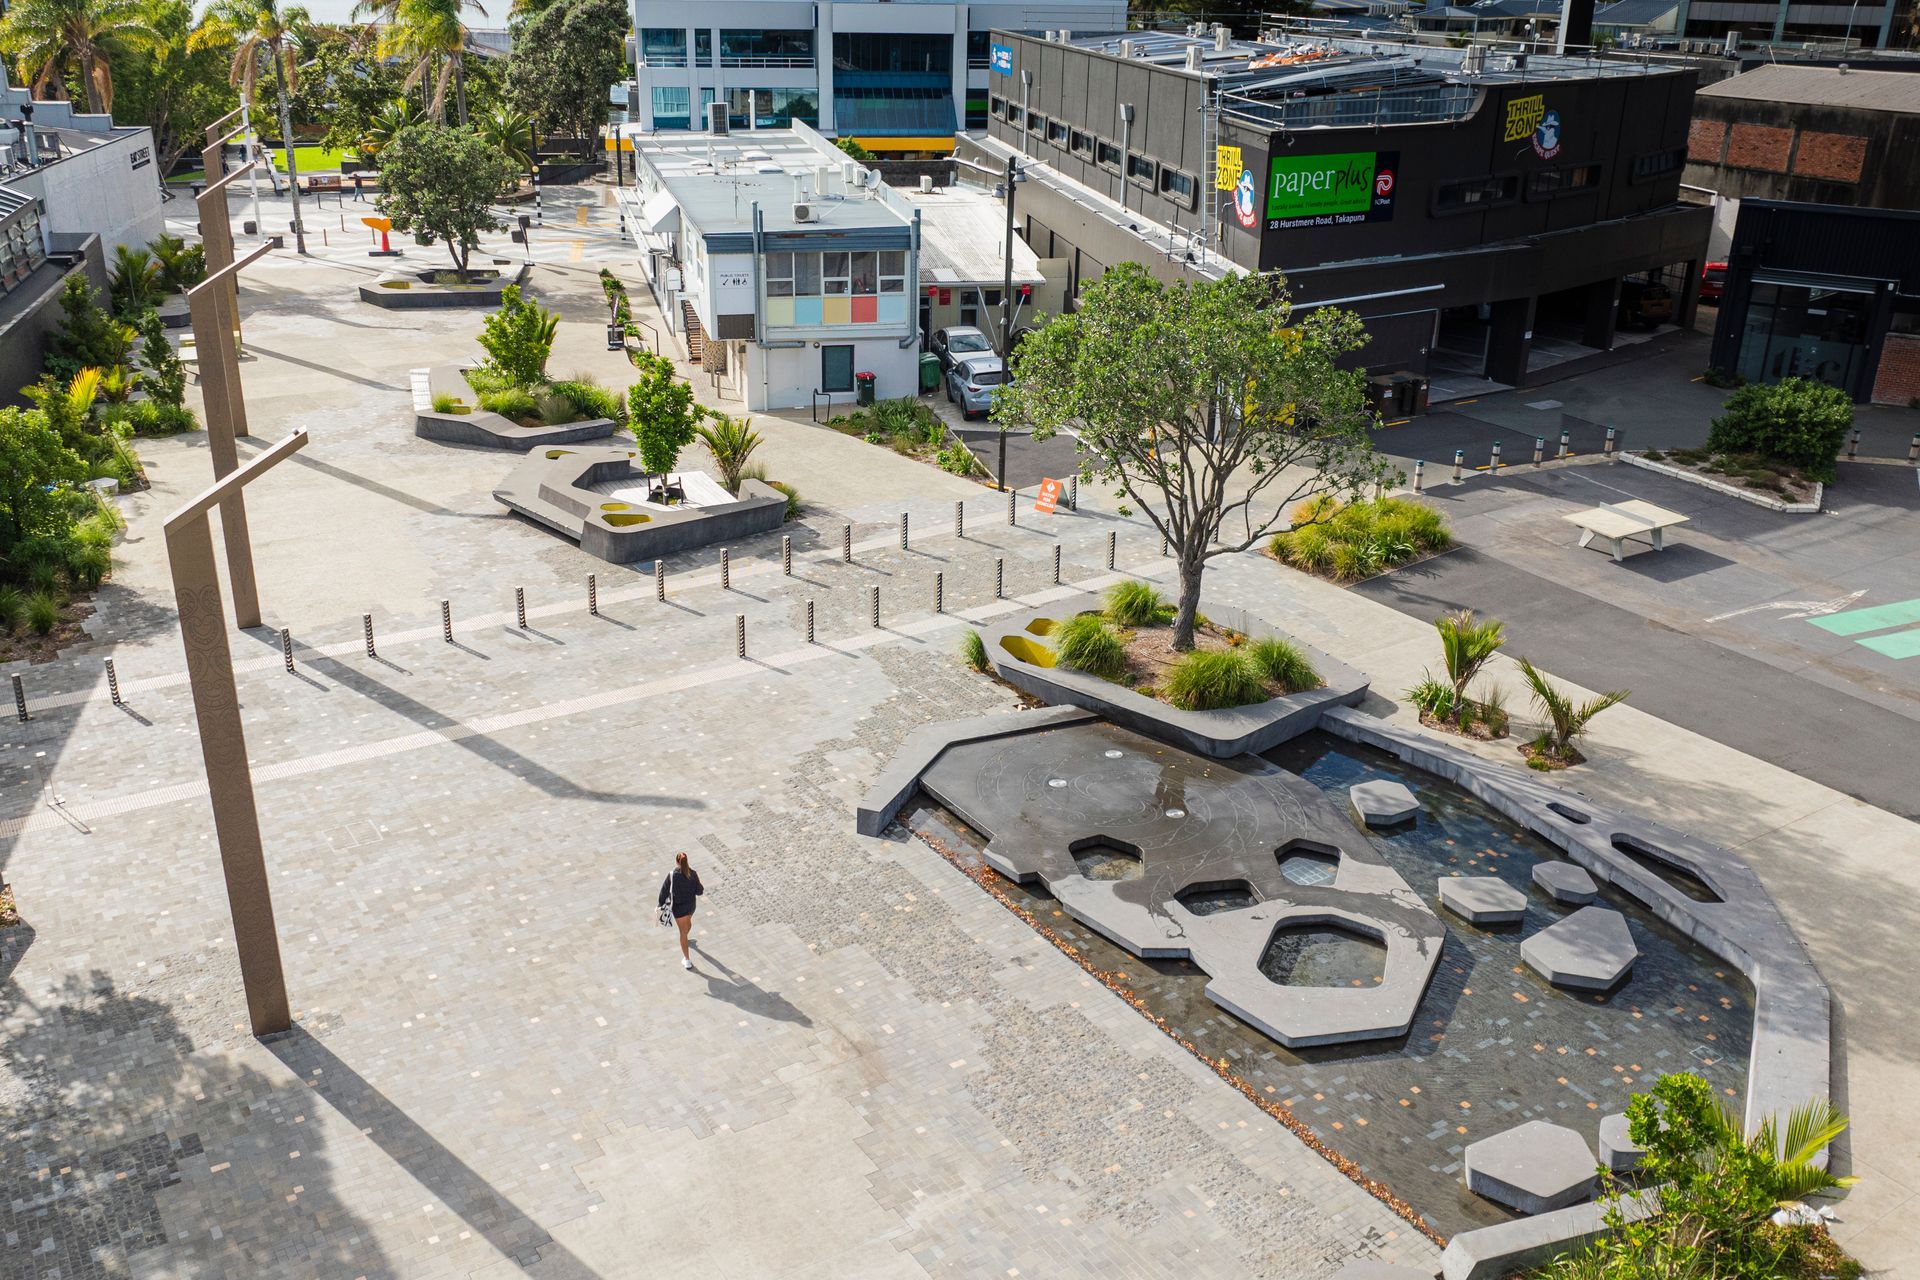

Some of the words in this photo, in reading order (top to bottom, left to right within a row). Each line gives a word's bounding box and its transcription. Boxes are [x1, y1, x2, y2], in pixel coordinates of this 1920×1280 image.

[1509, 96, 1543, 118] THRILL
[1506, 114, 1542, 138] ZONE
[1217, 149, 1241, 168] THRILL
[1217, 166, 1241, 188] ZONE
[1270, 220, 1279, 230] 28
[1280, 217, 1314, 229] Hurstmere
[1315, 215, 1334, 226] Road,
[1335, 214, 1366, 224] Takapuna
